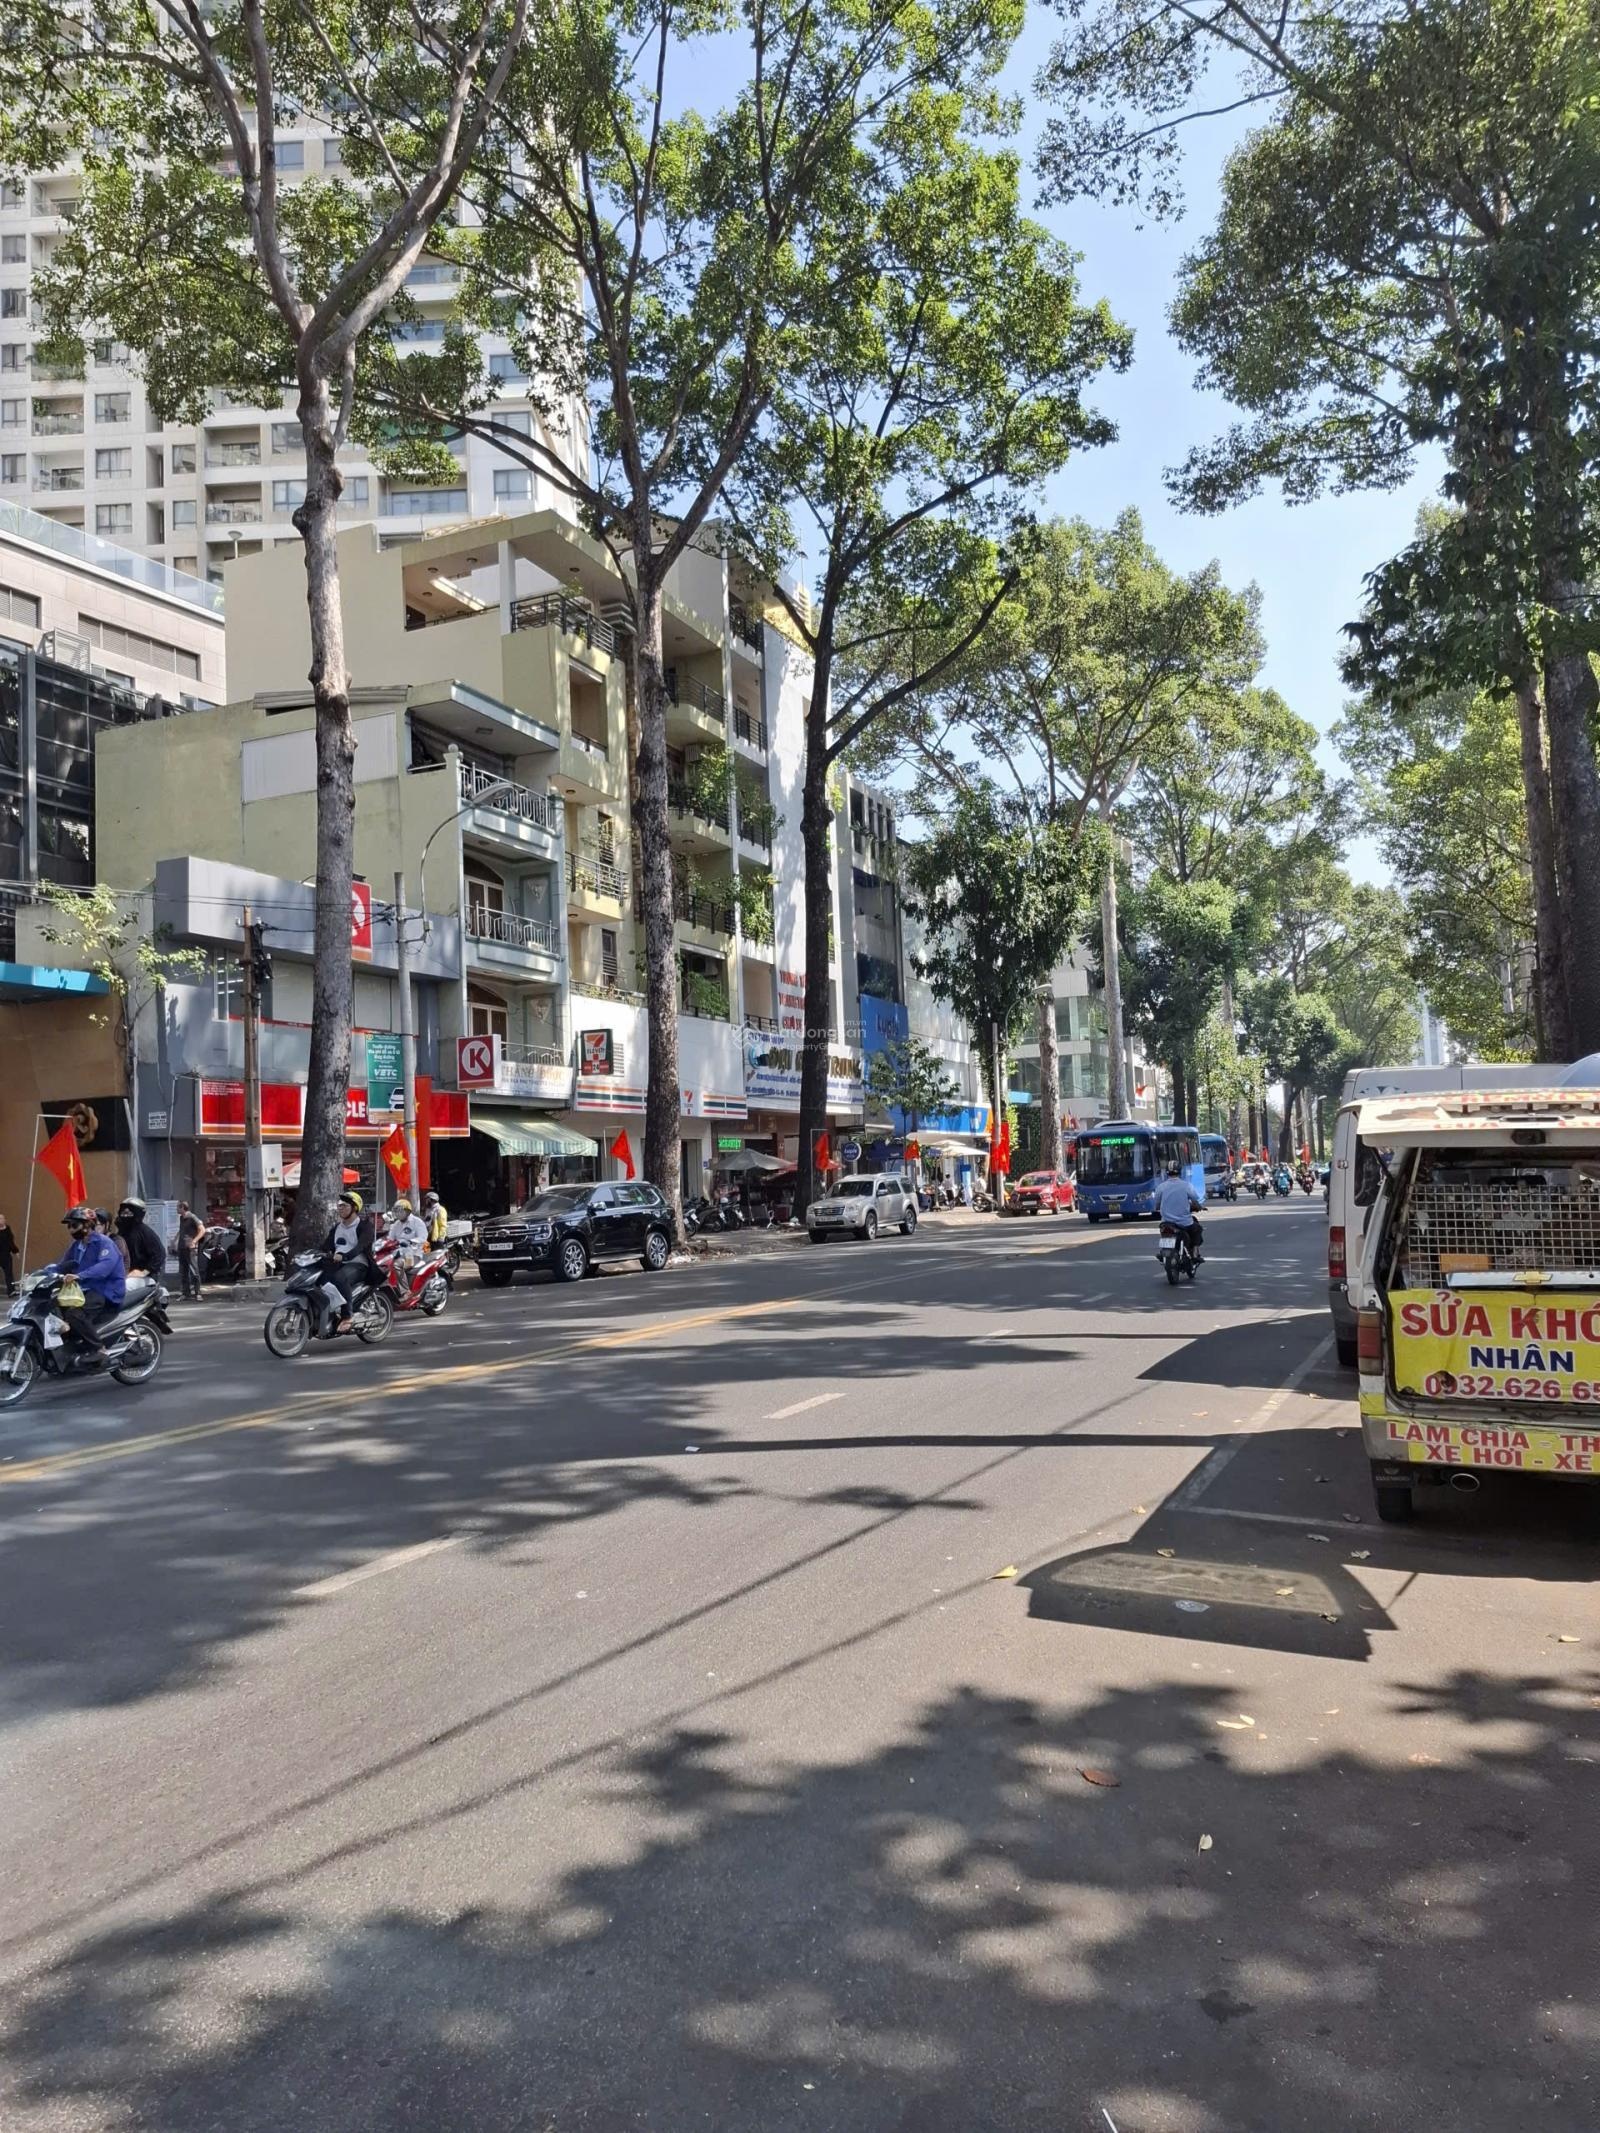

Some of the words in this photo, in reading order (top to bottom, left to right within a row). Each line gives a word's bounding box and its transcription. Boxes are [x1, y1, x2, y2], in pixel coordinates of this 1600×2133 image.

[374, 1068, 397, 1077] VETC
[469, 1046, 490, 1074] K
[346, 1101, 366, 1118] CLE
[1401, 1291, 1492, 1337] SỬA
[1470, 1344, 1574, 1373] NHÂN
[1388, 1420, 1450, 1443] LÀM
[1460, 1427, 1530, 1449] CHÌA
[1560, 1435, 1600, 1453] TH
[1427, 1444, 1461, 1462] XE
[1473, 1448, 1522, 1467] HƠI
[1554, 1453, 1592, 1471] XE
